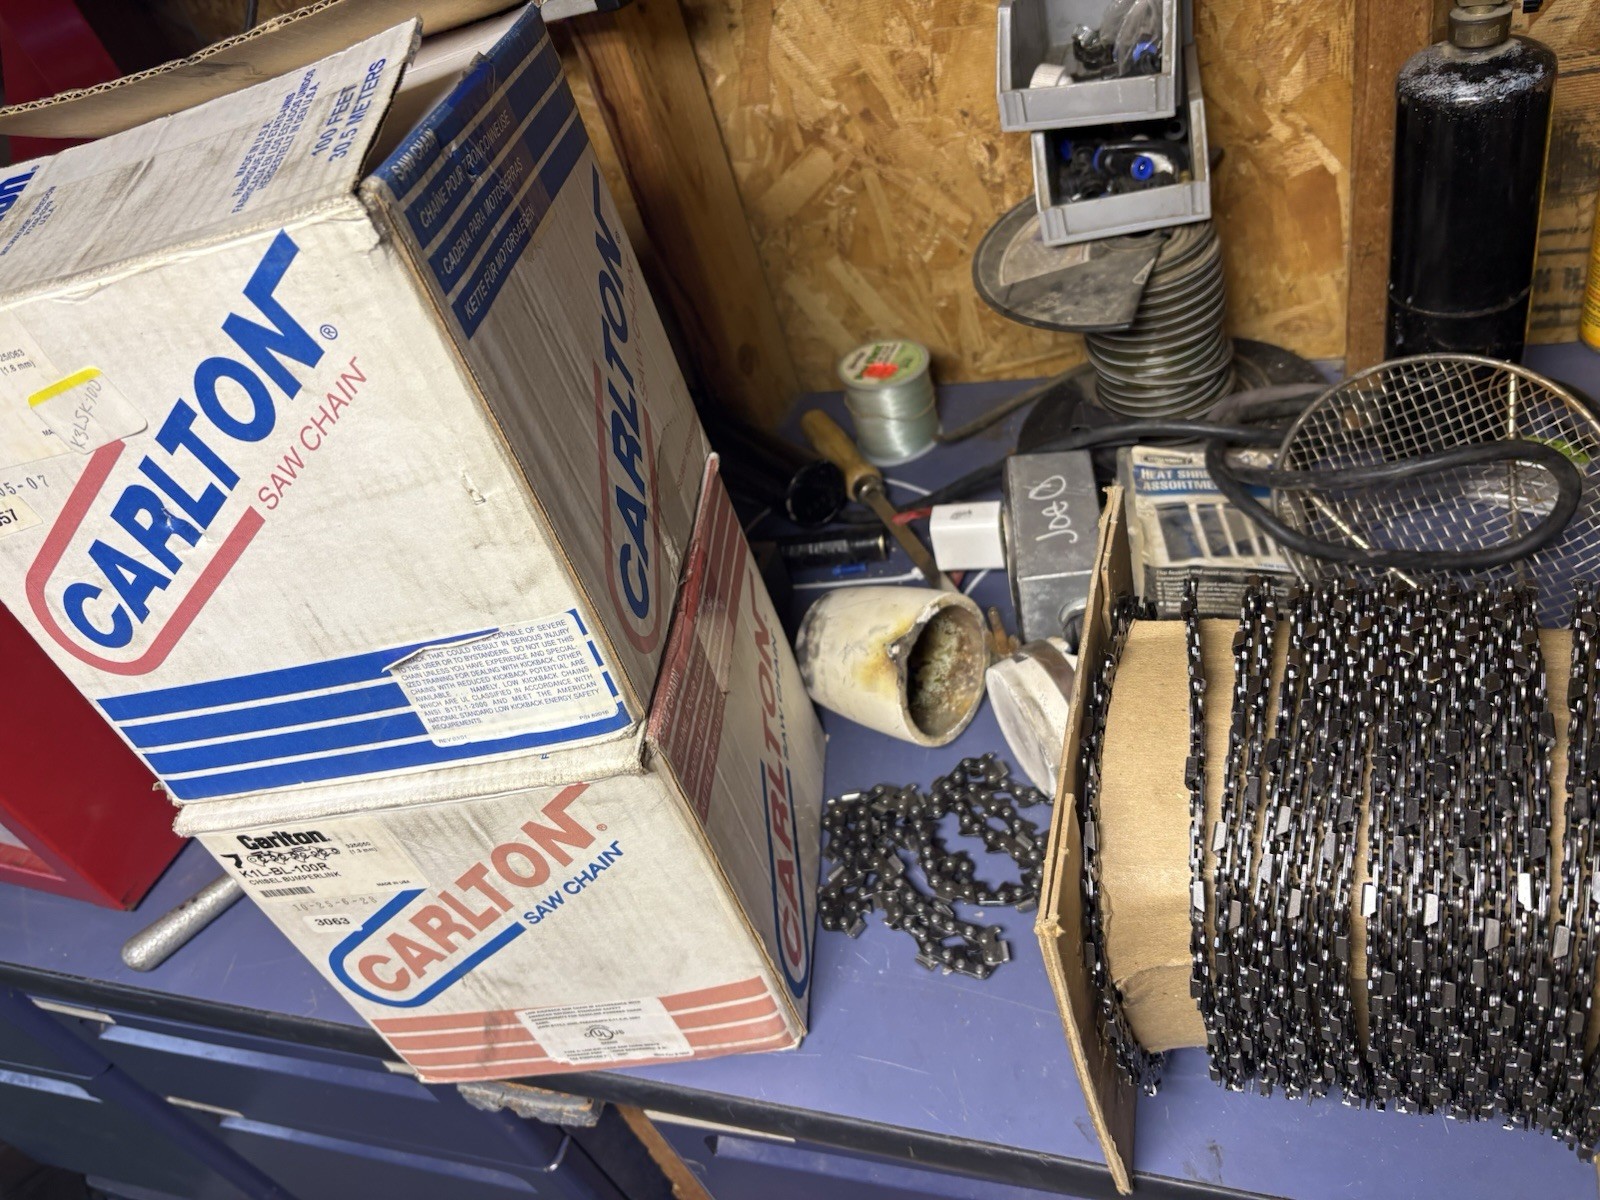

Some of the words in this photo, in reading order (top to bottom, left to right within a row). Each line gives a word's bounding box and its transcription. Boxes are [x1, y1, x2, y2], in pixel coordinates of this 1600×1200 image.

[311, 128, 338, 156] 100
[327, 84, 357, 126] FEET
[328, 128, 357, 162] 30.5
[346, 58, 386, 126] METERS
[233, 152, 255, 178] MADE
[246, 143, 260, 155] IN
[391, 152, 414, 181] SAW
[414, 128, 439, 159] CHAIN
[446, 163, 468, 197] POUR
[442, 233, 471, 274] CADENA
[469, 210, 486, 243] PARA
[464, 279, 488, 320] KETTE
[592, 162, 649, 620] CARLTON
[63, 228, 325, 649] CARLTON
[258, 447, 305, 510] SAW
[300, 356, 367, 452] CHAIN
[1141, 468, 1172, 480] HEAT
[426, 651, 446, 660] THAT
[445, 646, 471, 656] COULD
[471, 641, 499, 651] RESULT
[509, 633, 543, 645] SERIOUS
[543, 627, 571, 638] INJURY
[491, 628, 524, 640] CAPABLE
[524, 626, 536, 634] OF
[536, 619, 567, 631] SEVERE
[400, 671, 423, 681] CHAIN
[422, 666, 451, 677] UNLESS
[450, 664, 465, 672] YOU
[464, 661, 484, 669] HAVE
[484, 652, 530, 666] EXPERIENCE
[528, 649, 545, 658] AND
[545, 643, 578, 654] SPECIAL-
[405, 680, 422, 688] IZED
[421, 674, 454, 685] TRAINING
[454, 671, 470, 679] FOR
[469, 666, 500, 677] DEALING
[500, 662, 519, 671] WITH
[556, 651, 582, 660] OTHER
[406, 664, 421, 672] THE
[420, 660, 441, 669] USER
[524, 642, 540, 650] NOT
[540, 638, 557, 647] USE
[556, 635, 575, 644] THIS
[409, 685, 436, 695] CHAINS
[436, 682, 455, 690] WITH
[455, 675, 491, 687] REDUCED
[491, 669, 528, 681] KICKBACK
[528, 662, 568, 674] POTENTIAL
[569, 658, 586, 666] ARE
[414, 690, 451, 702] AVAILABLE
[501, 679, 519, 687] LOW
[521, 672, 558, 684] KICKBACK
[560, 666, 589, 676] CHAINS
[418, 700, 442, 709] WHICH
[470, 688, 512, 701] CLASSIFIED
[522, 677, 572, 692] ACCORDANCE
[573, 673, 593, 682] WITH
[422, 708, 442, 716] ANSI
[491, 697, 508, 705] AND
[511, 692, 533, 702] MEET
[536, 689, 552, 697] THE
[555, 681, 597, 693] AMERICAN
[426, 713, 459, 724] NATIONAL
[458, 708, 494, 718] STANDARD
[509, 698, 544, 710] KICKBACK
[543, 694, 573, 704] ENERGY
[572, 689, 600, 698] SAFETY
[658, 711, 671, 741] SAW
[665, 667, 681, 709] CHAIN
[437, 736, 452, 744] REV
[749, 568, 801, 968] CARLTON
[236, 829, 329, 851] Carlton
[239, 862, 330, 880] K1L-BL-100R
[248, 876, 283, 887] CHISEL
[283, 871, 342, 885] BUMPERLINK
[358, 781, 596, 992] CARLTON
[523, 890, 565, 925] SAW
[563, 840, 624, 895] CHAIN
[314, 917, 350, 926] 3063
